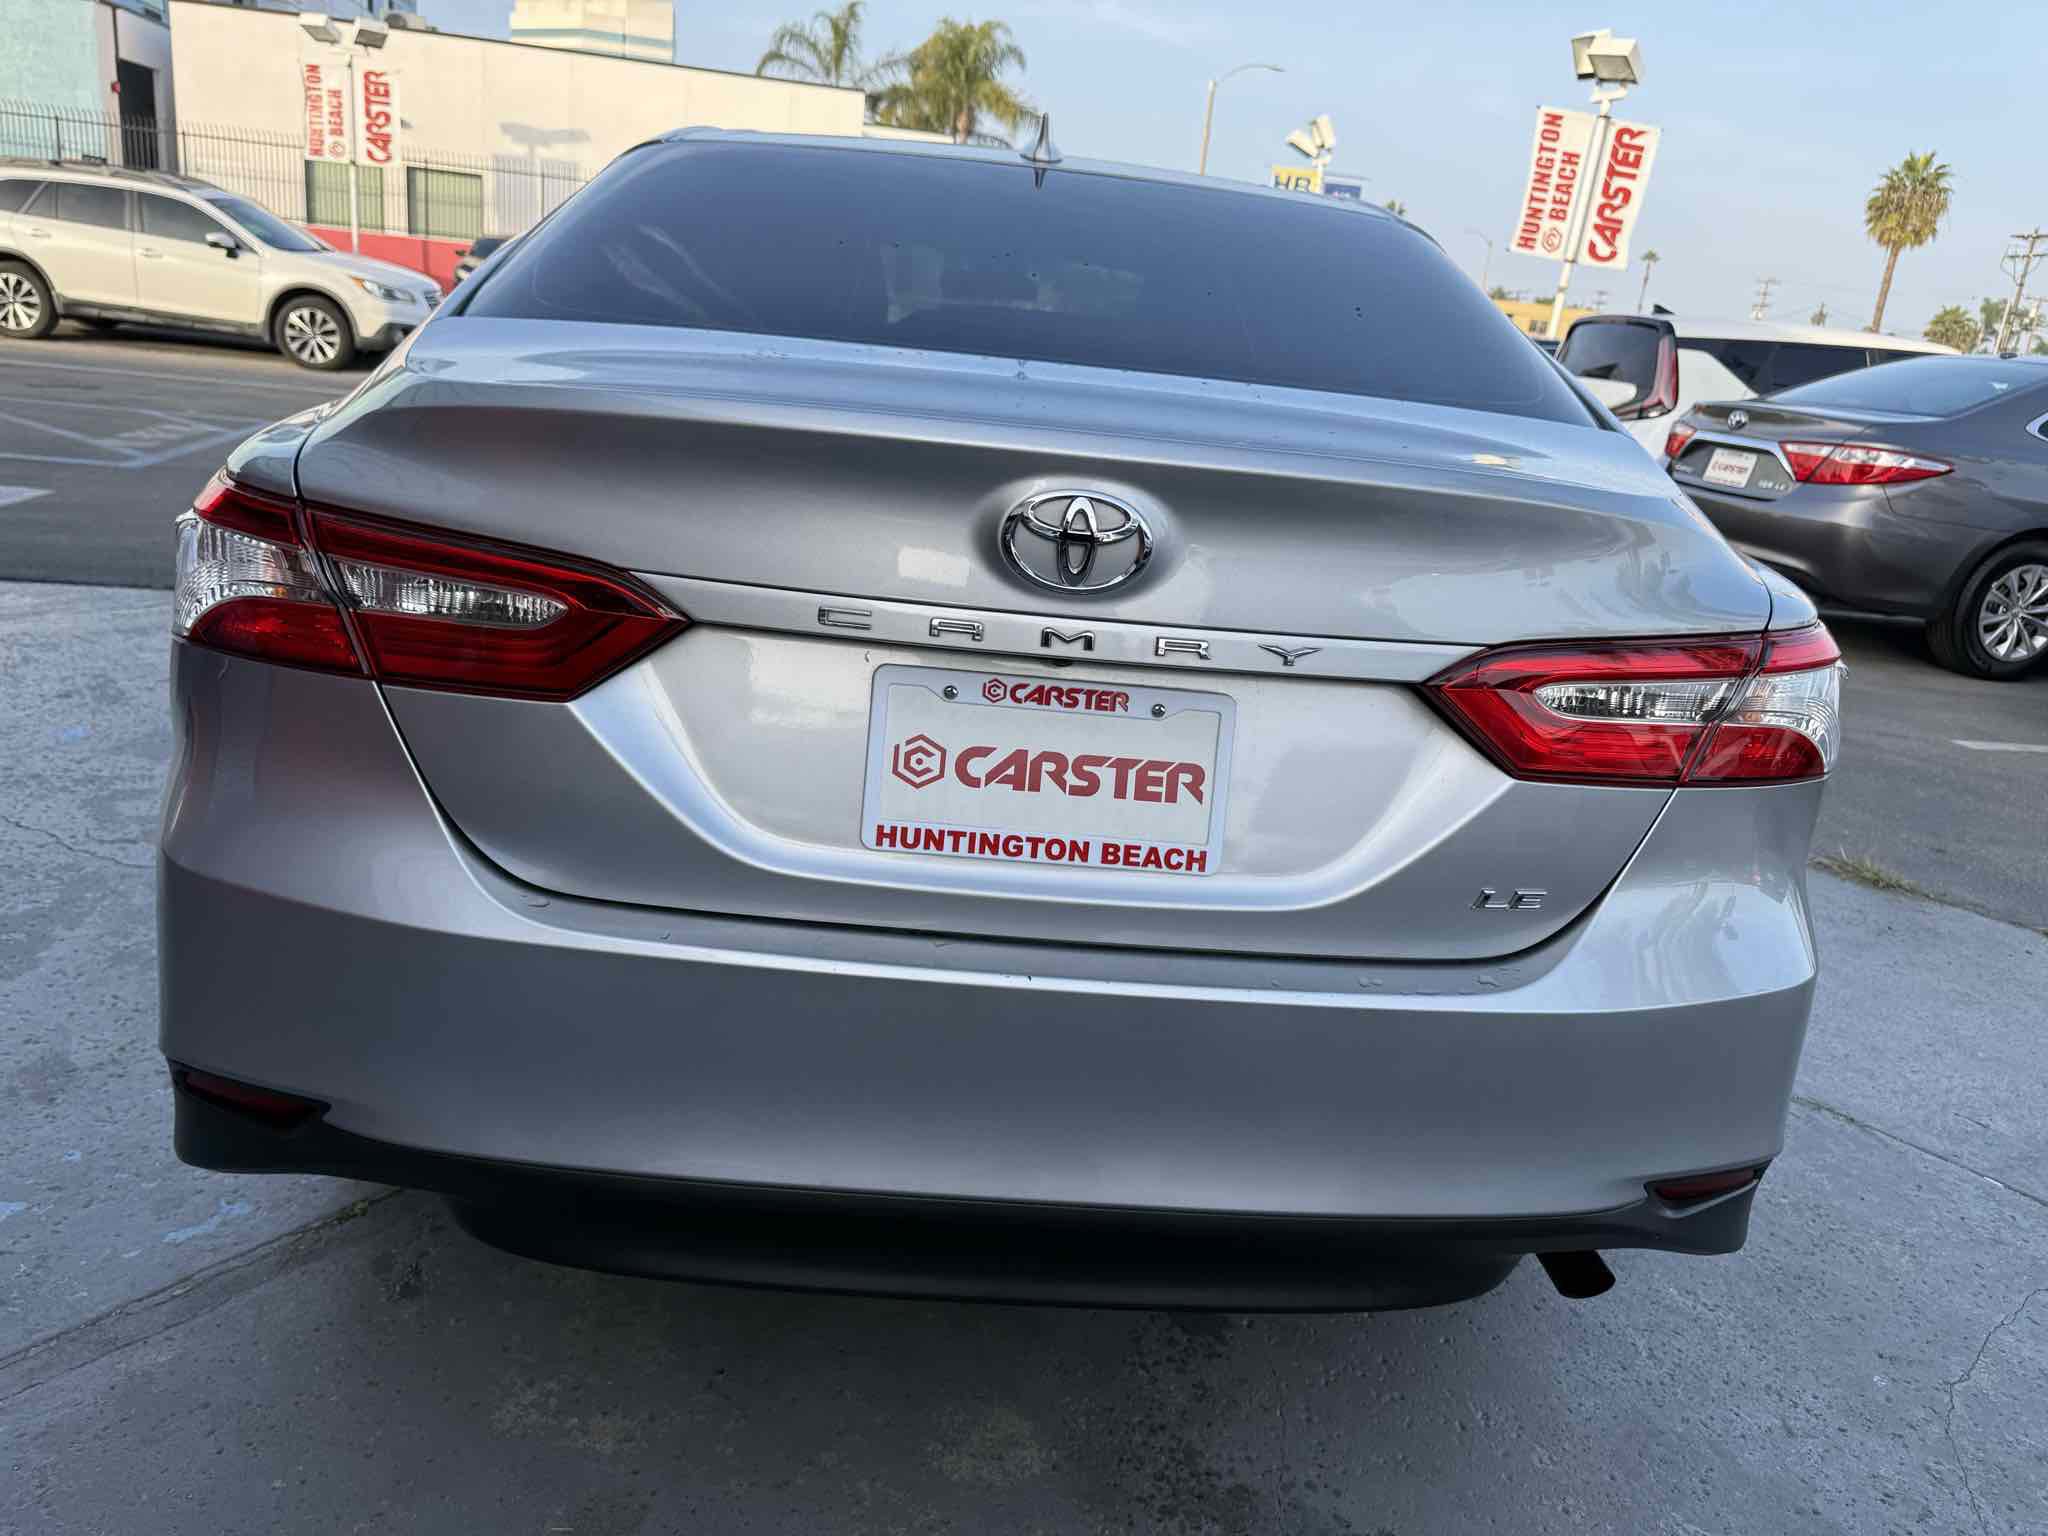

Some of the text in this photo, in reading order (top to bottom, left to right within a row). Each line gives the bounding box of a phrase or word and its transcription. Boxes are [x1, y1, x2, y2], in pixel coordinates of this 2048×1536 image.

[305, 64, 324, 157] HUNTINGTON
[328, 89, 344, 137] BEACH
[363, 70, 393, 164] CARSTER
[1516, 112, 1564, 250] HUNTINGTON
[1548, 151, 1581, 222] BEACH
[1588, 127, 1647, 262] CARSTER
[817, 605, 1322, 667] CAMRY
[1009, 682, 1130, 713] CARSTER
[954, 745, 1206, 804] CARSTER
[875, 823, 1208, 873] HUNTINGTON BEACH
[1470, 888, 1548, 912] LE
